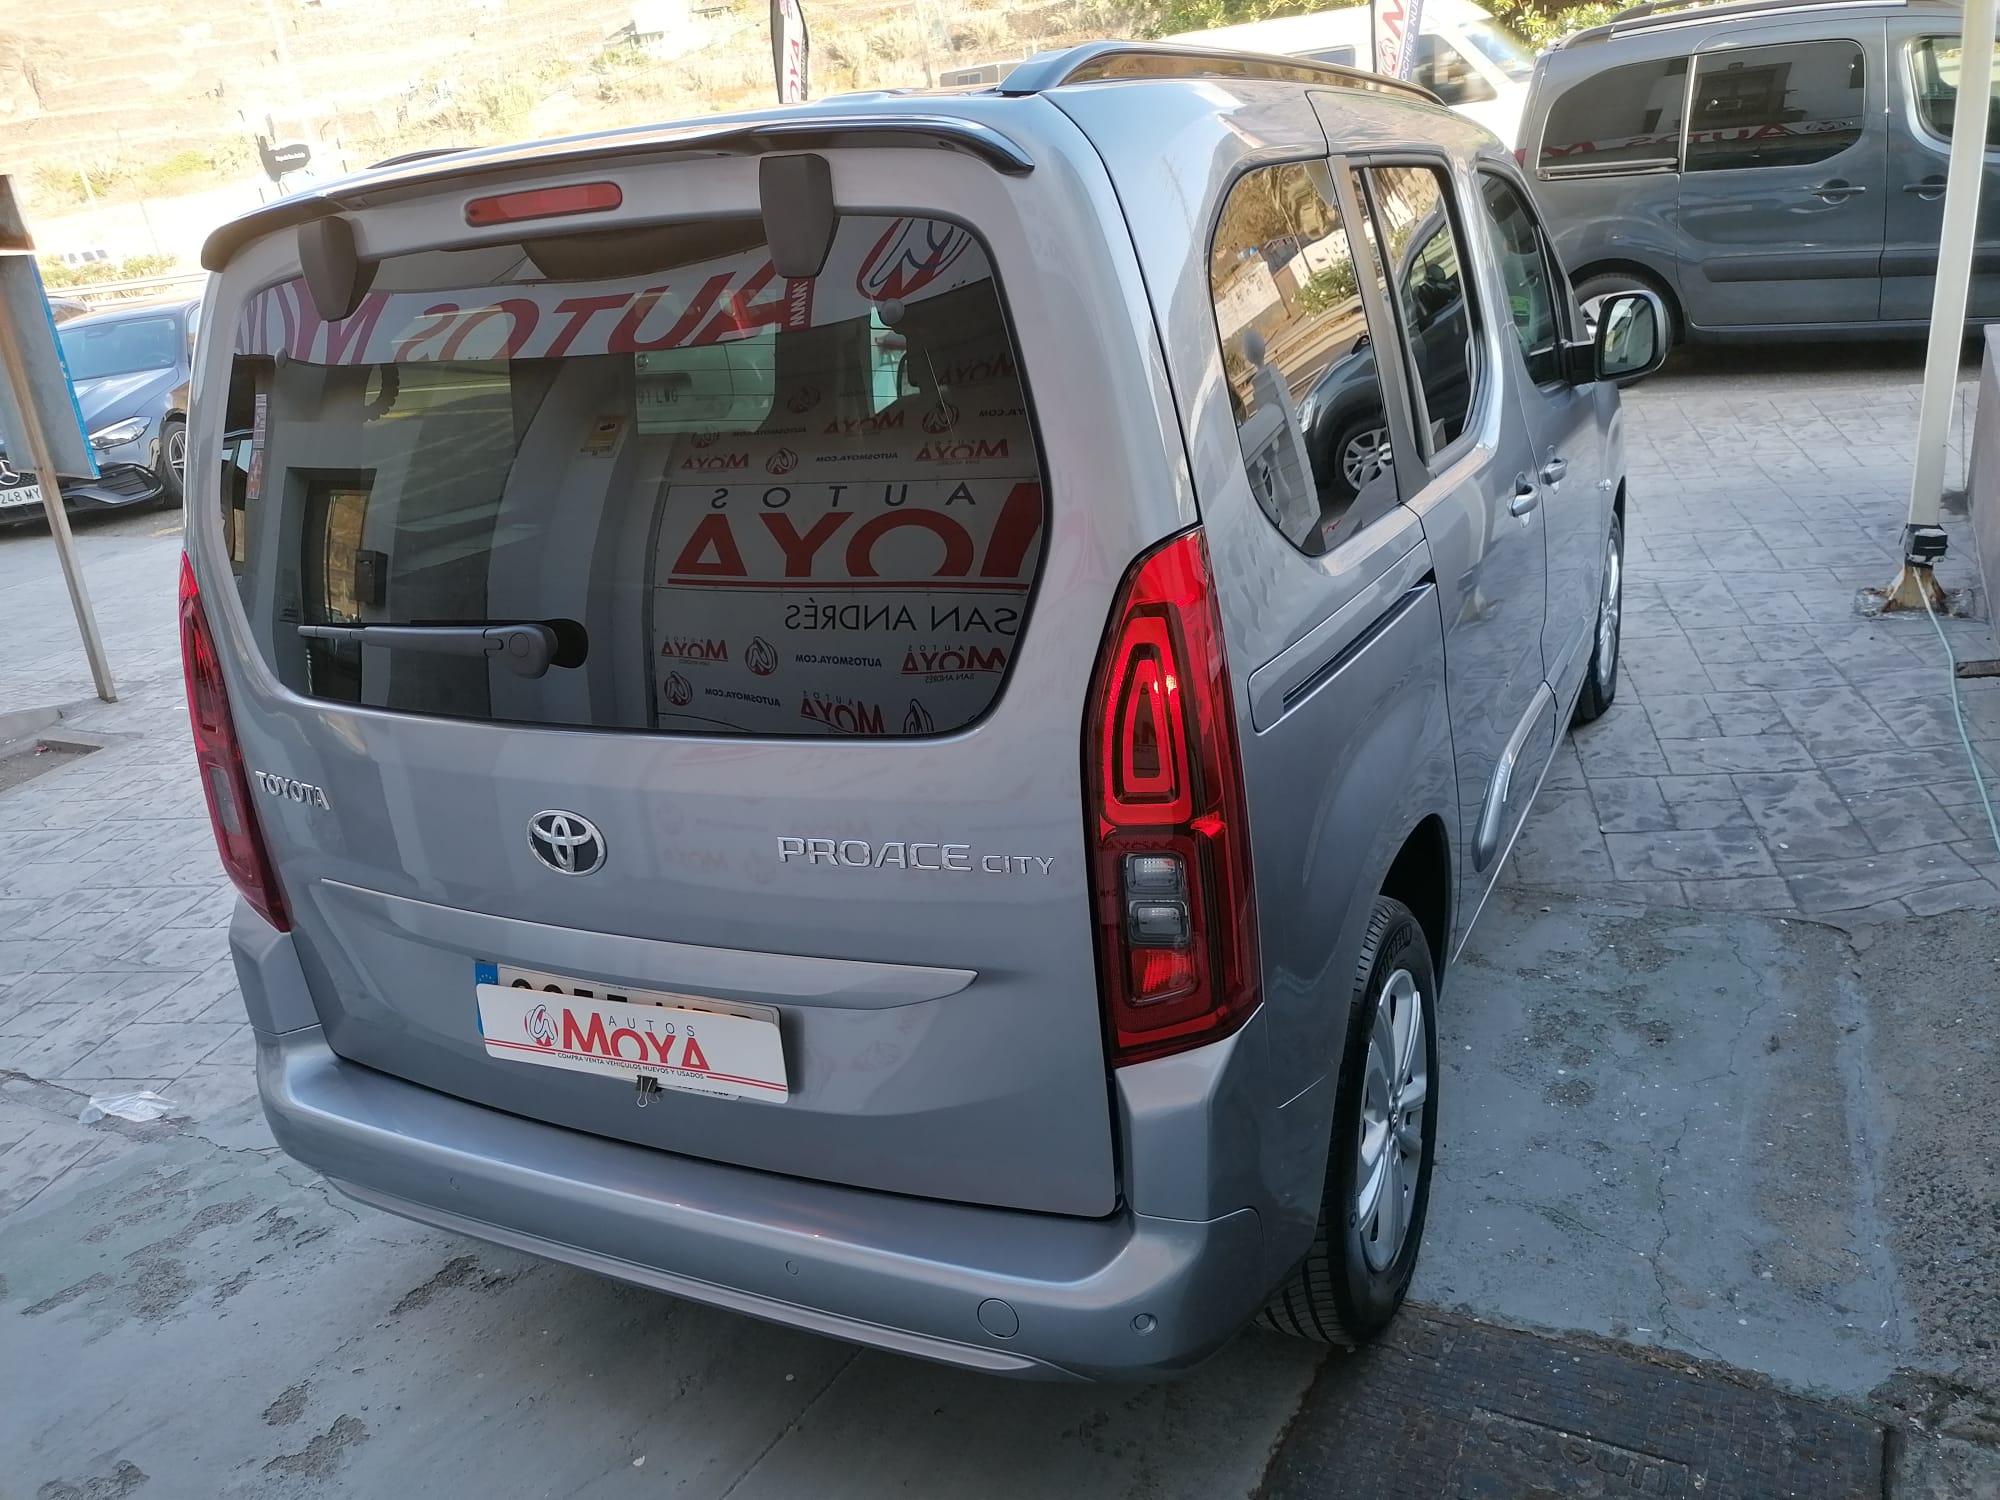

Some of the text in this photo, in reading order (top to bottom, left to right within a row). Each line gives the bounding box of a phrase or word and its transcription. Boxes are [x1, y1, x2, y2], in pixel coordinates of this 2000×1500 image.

[255, 770, 331, 811] TOYOTA
[776, 836, 1055, 876] PROACE CITY
[562, 1008, 711, 1071] MOYA
[608, 1015, 696, 1037] AUTOS
[557, 1052, 584, 1062] COMPRA
[584, 1056, 605, 1065] VENTA
[643, 1065, 669, 1075] NUEVOS
[677, 1071, 705, 1080] USADOS
